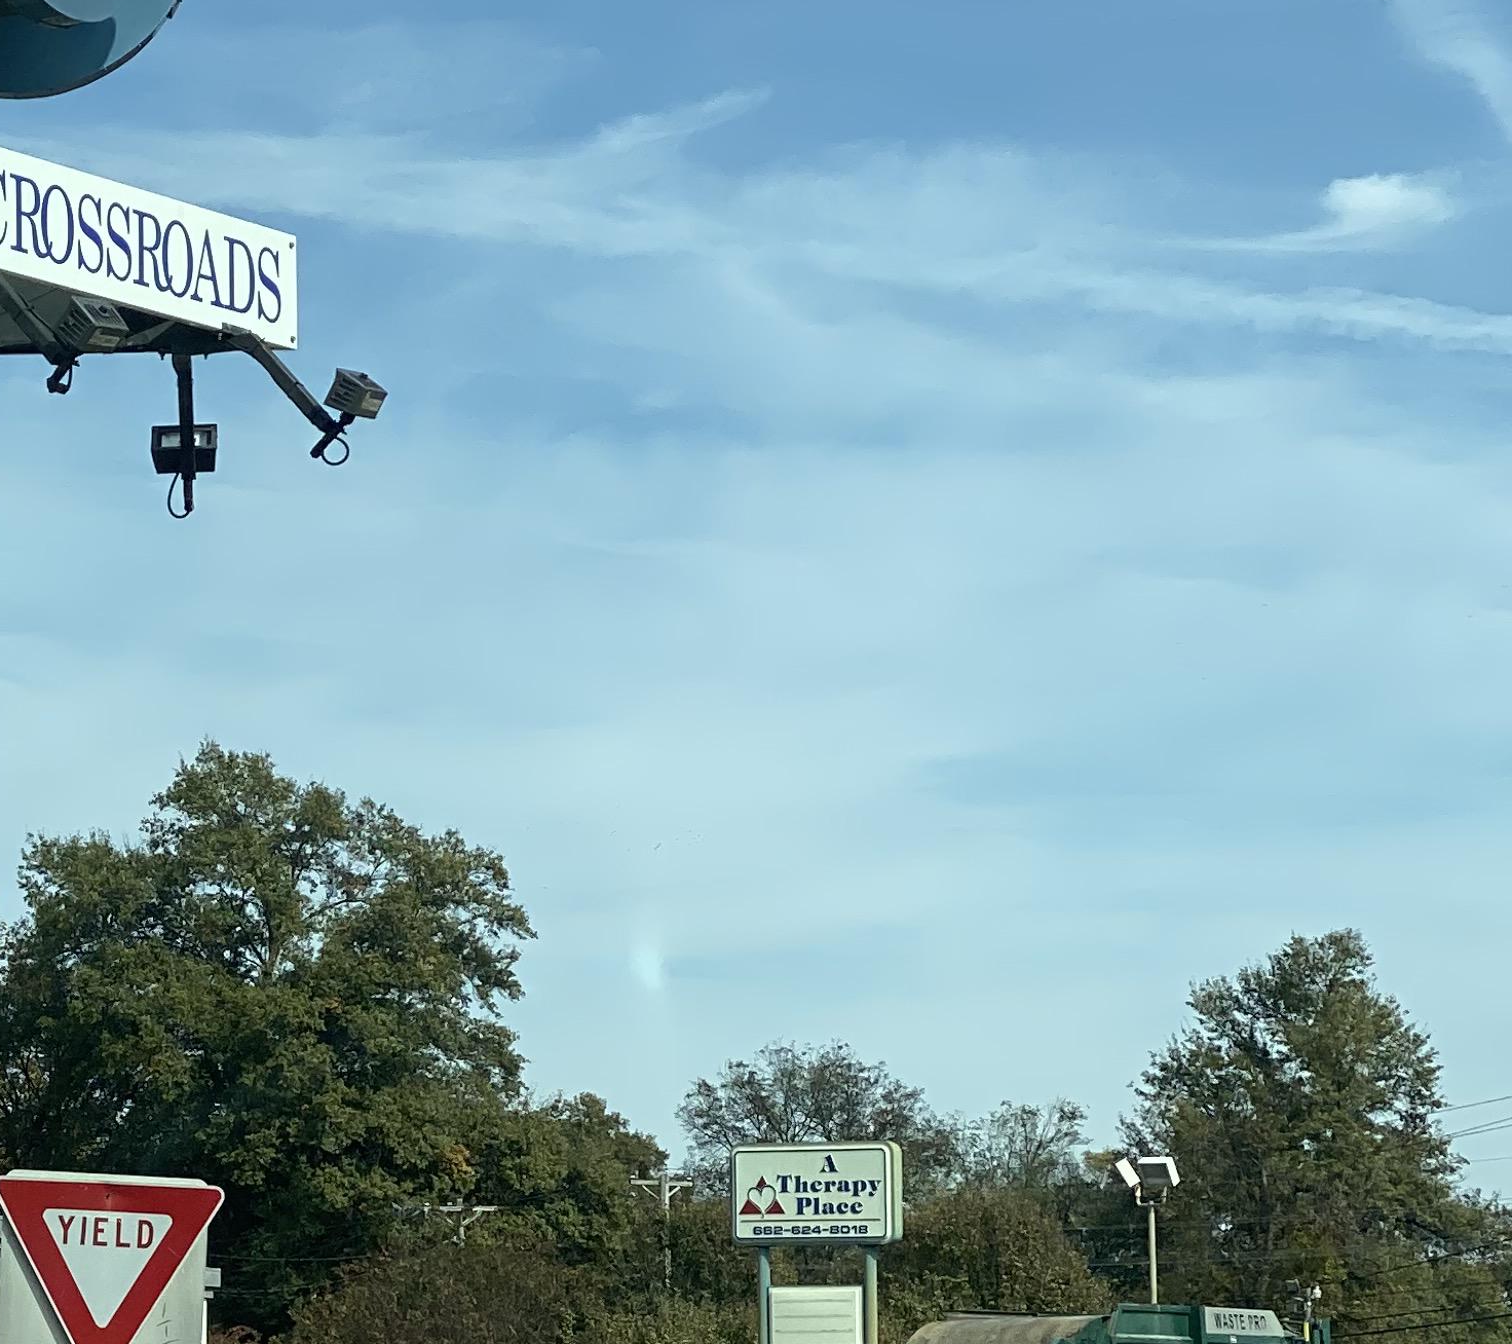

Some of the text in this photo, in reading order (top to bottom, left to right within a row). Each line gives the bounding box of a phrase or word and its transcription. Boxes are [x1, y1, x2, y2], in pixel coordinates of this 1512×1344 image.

[819, 1154, 838, 1173] A
[775, 1174, 882, 1197] Therapy
[795, 1197, 864, 1216] Place
[58, 1215, 154, 1249] YIELD
[1213, 1313, 1267, 1330] WASTE PRO
